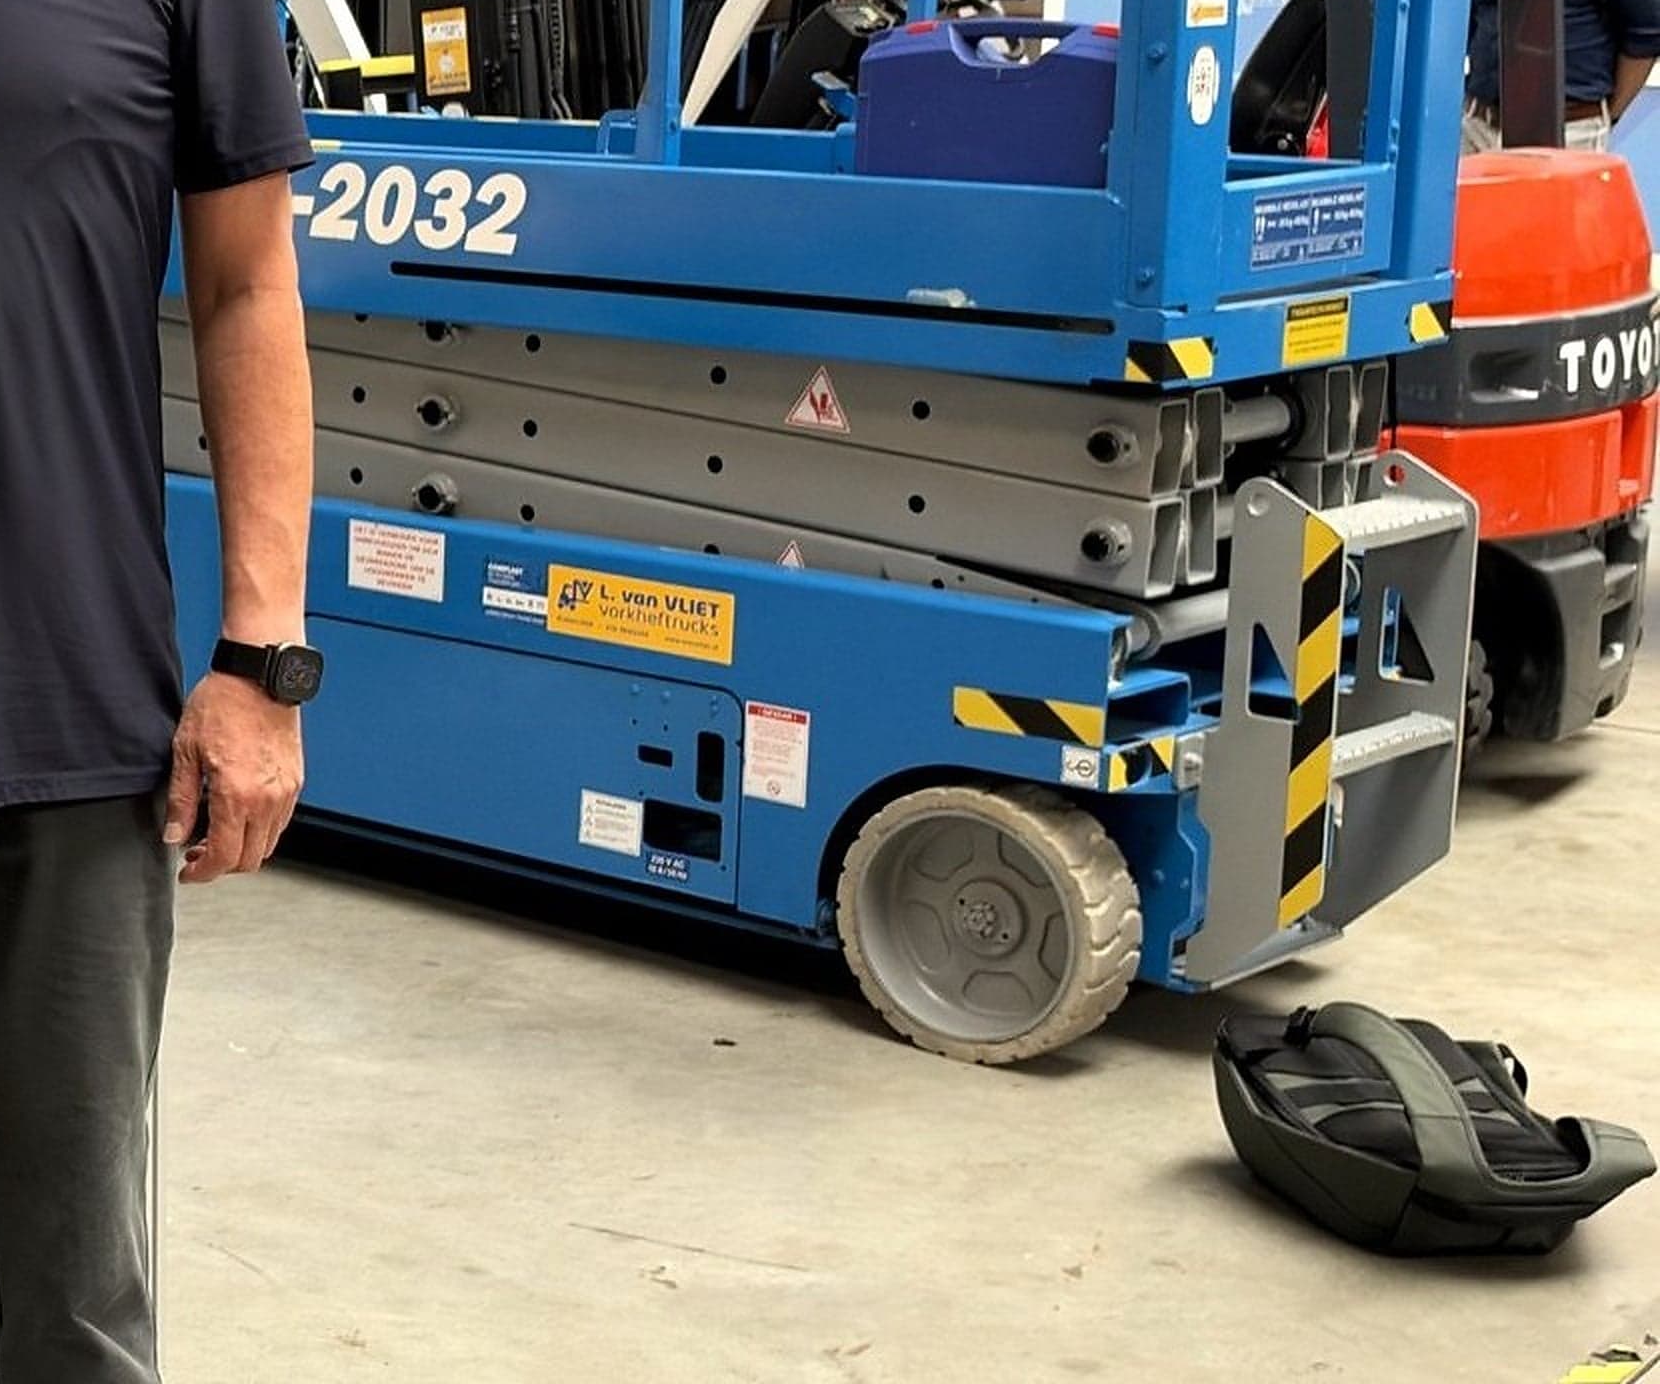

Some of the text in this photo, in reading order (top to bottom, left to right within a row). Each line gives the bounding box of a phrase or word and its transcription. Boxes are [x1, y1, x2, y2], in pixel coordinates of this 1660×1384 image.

[600, 585, 720, 618] L. van VLIET
[599, 604, 719, 636] vorkheftrucks
